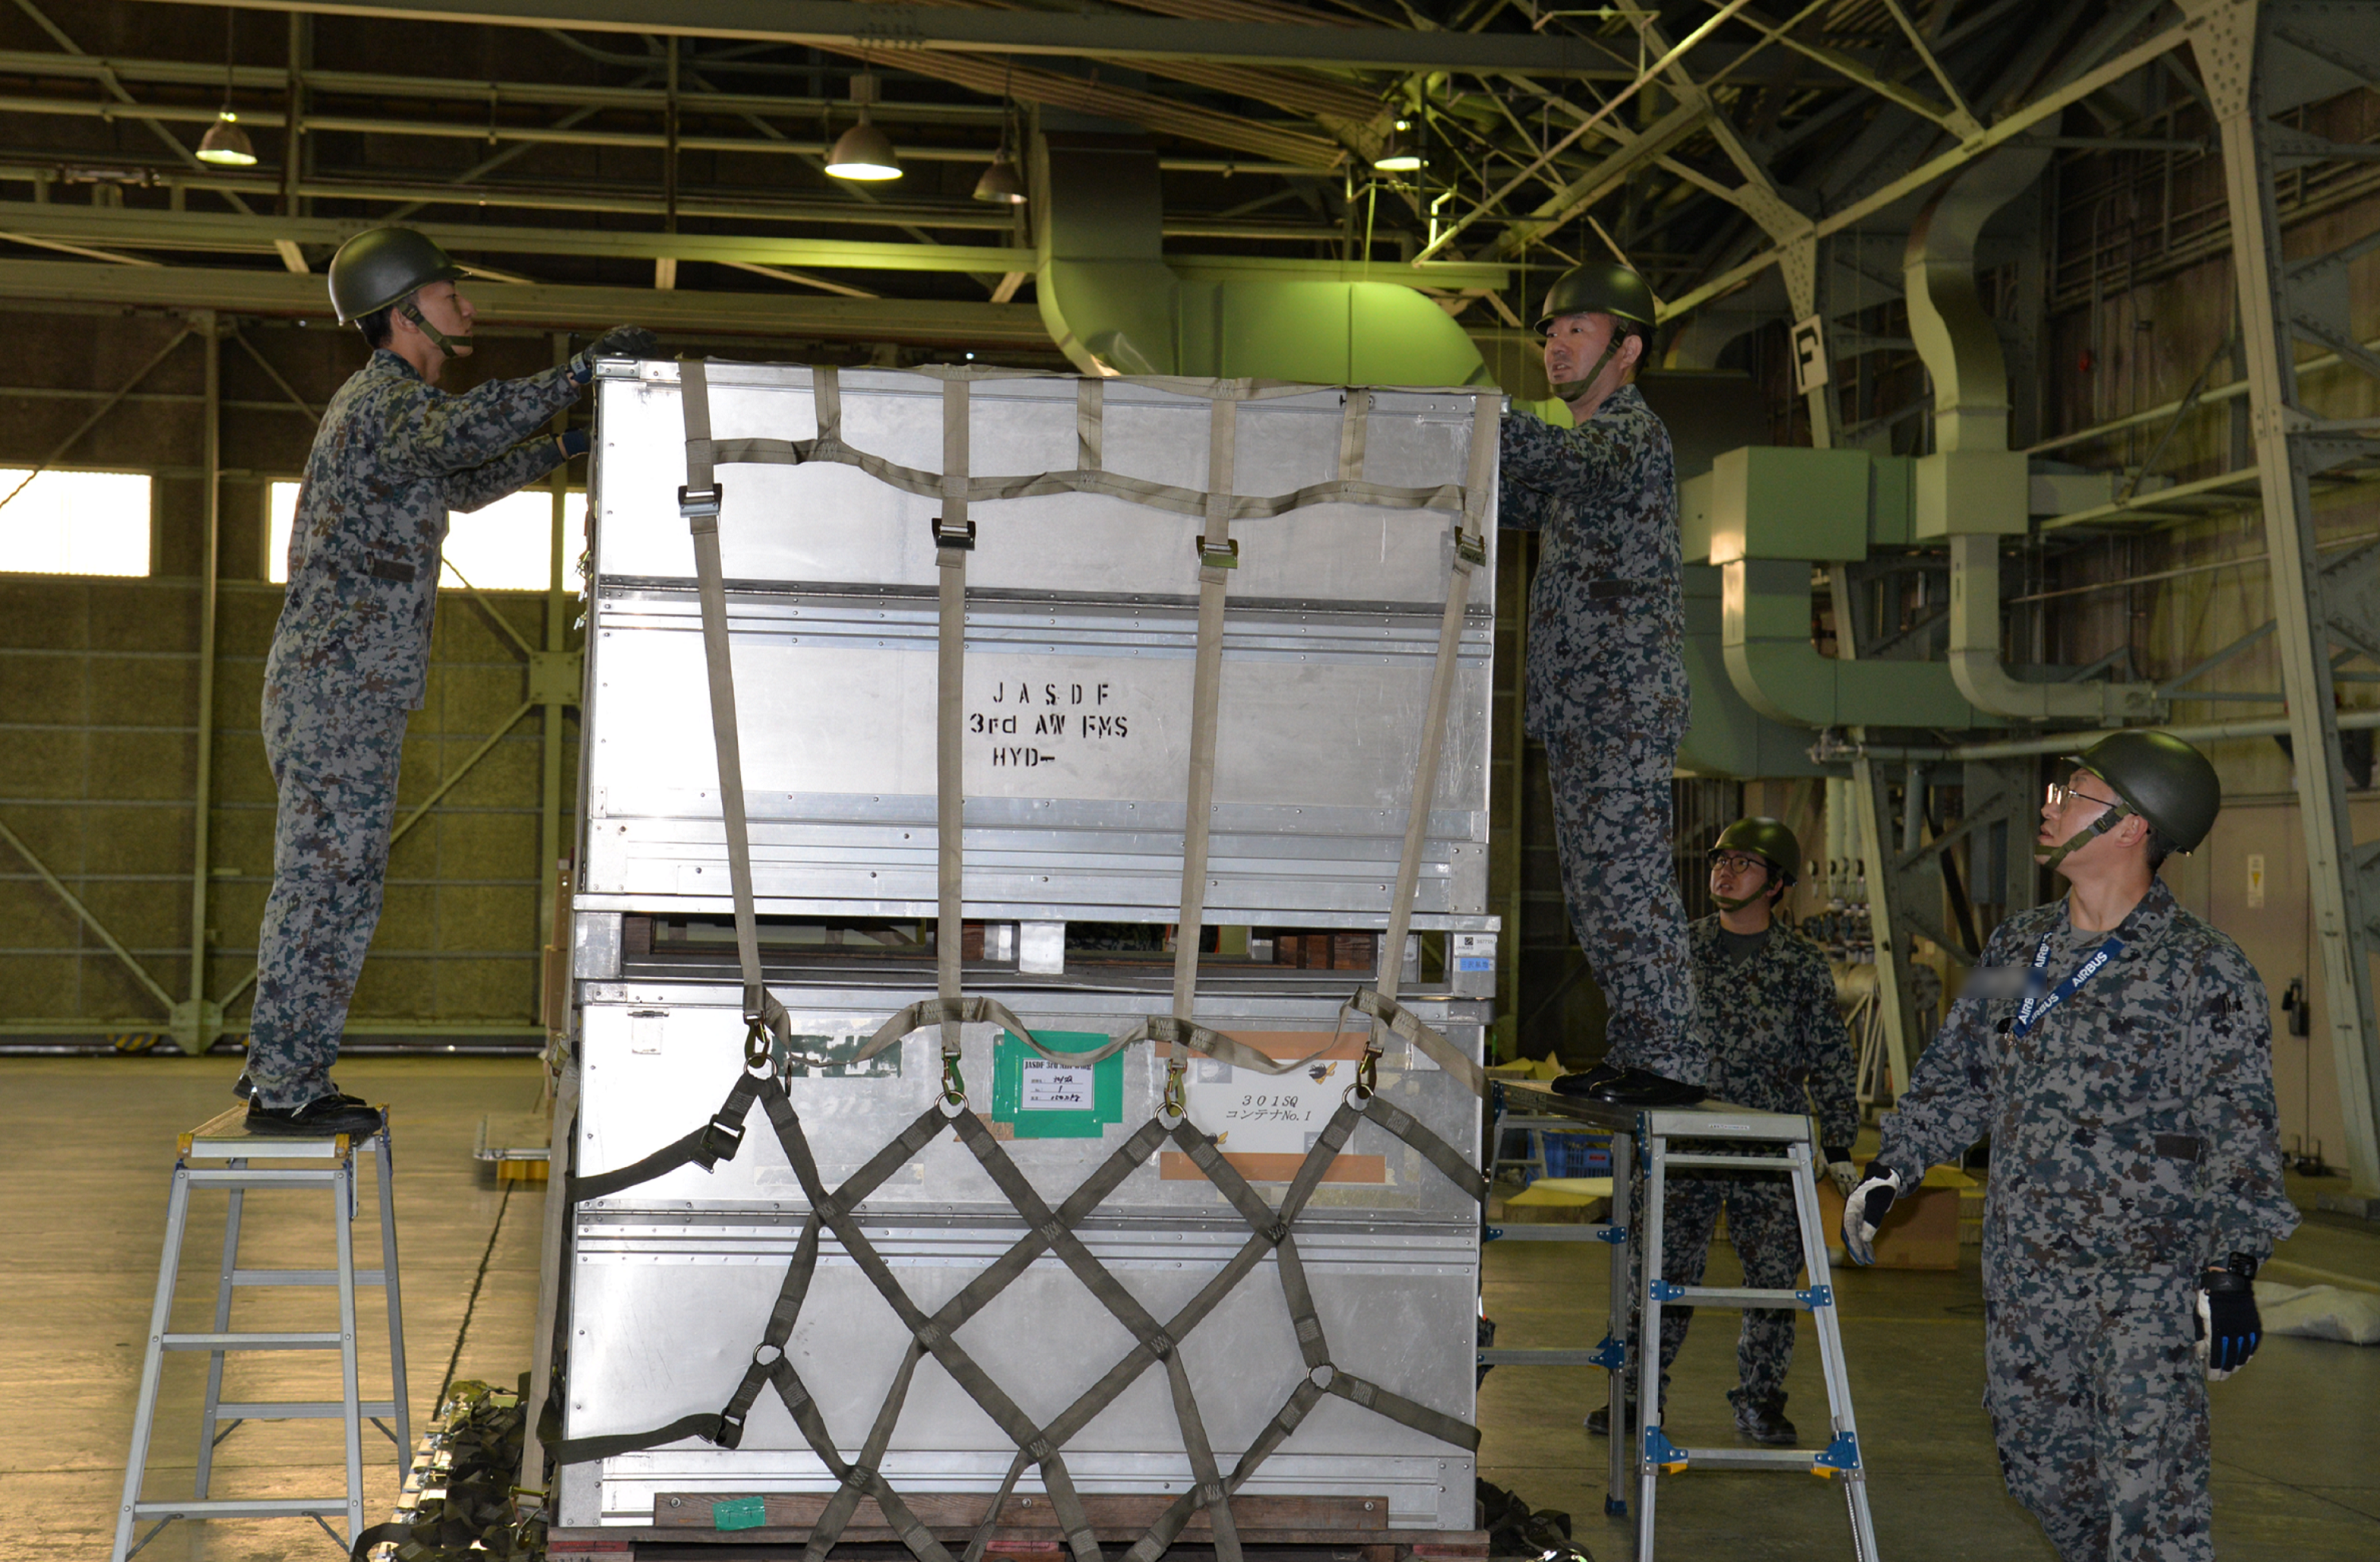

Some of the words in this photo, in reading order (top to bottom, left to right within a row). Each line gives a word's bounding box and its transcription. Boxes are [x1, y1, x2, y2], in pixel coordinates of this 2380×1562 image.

[1796, 325, 1819, 387] F
[970, 713, 1017, 735] 3rd
[1036, 714, 1065, 735] AW
[2071, 951, 2108, 988] AIRBUS
[2030, 992, 2059, 1023] IRBUS
[1024, 1061, 1046, 1070] JASDF
